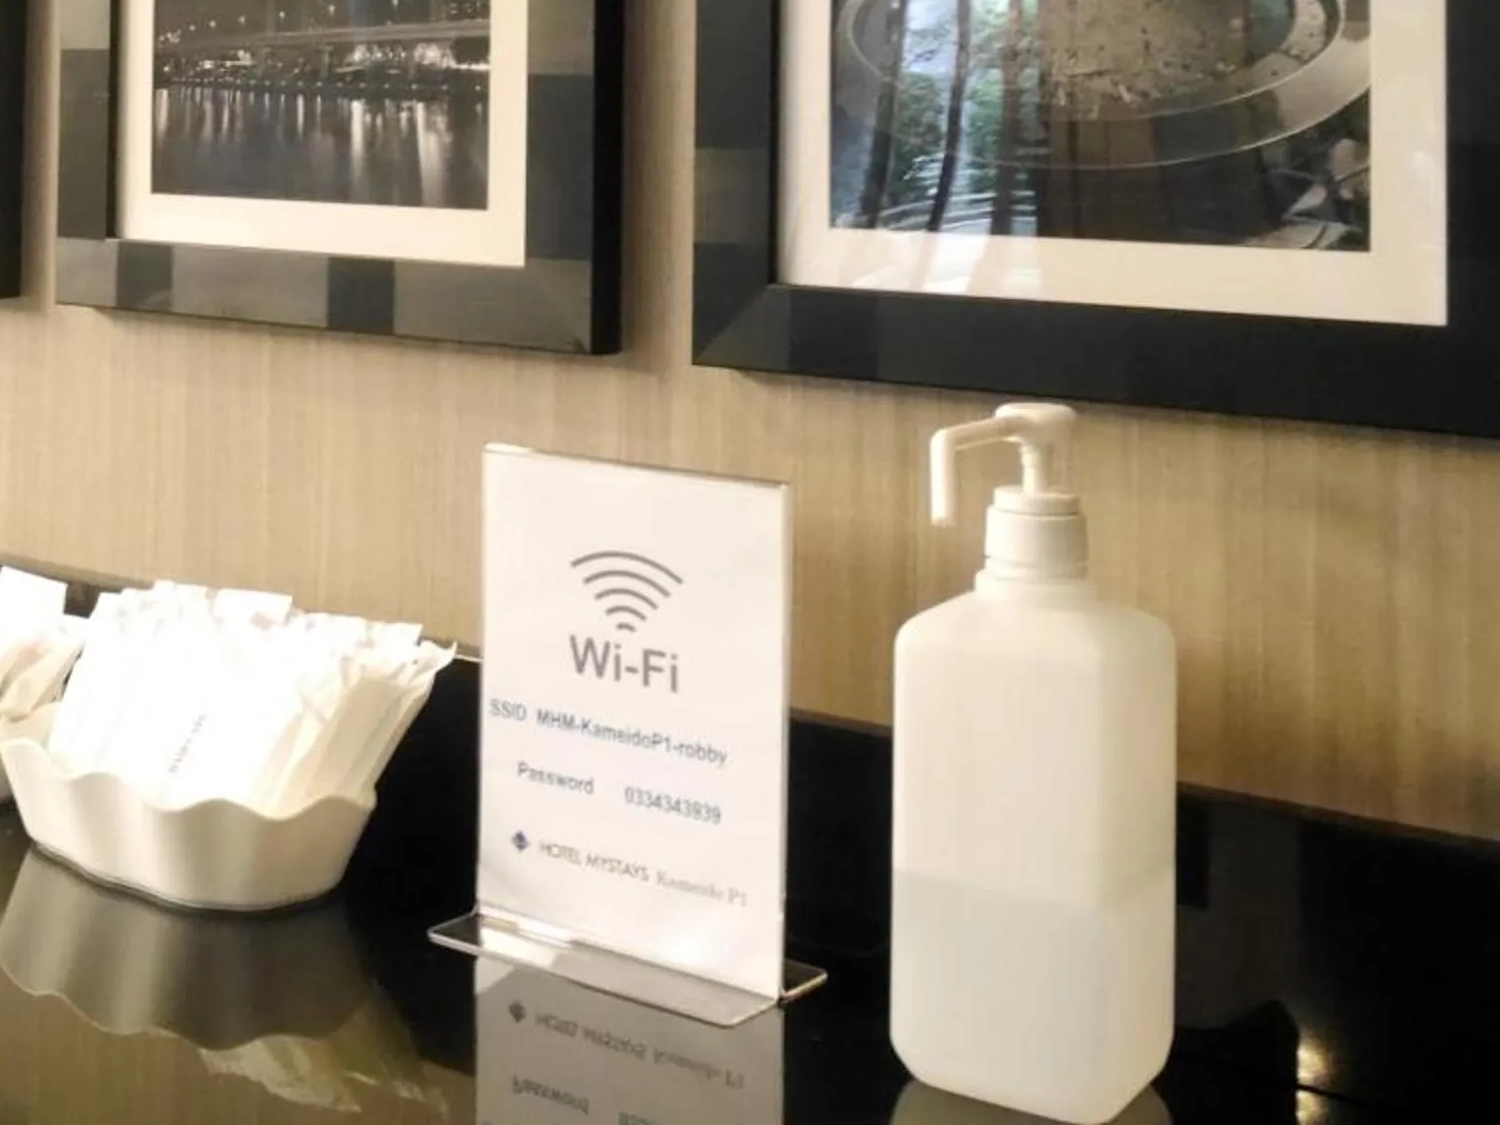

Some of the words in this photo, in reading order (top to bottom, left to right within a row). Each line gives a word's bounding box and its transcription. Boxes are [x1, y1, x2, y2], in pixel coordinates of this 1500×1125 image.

[569, 634, 679, 693] Wi-Fi
[489, 698, 527, 721] SSID
[517, 761, 595, 795] Password
[539, 841, 582, 866] HOTEL
[584, 853, 651, 883] MYSTAYS
